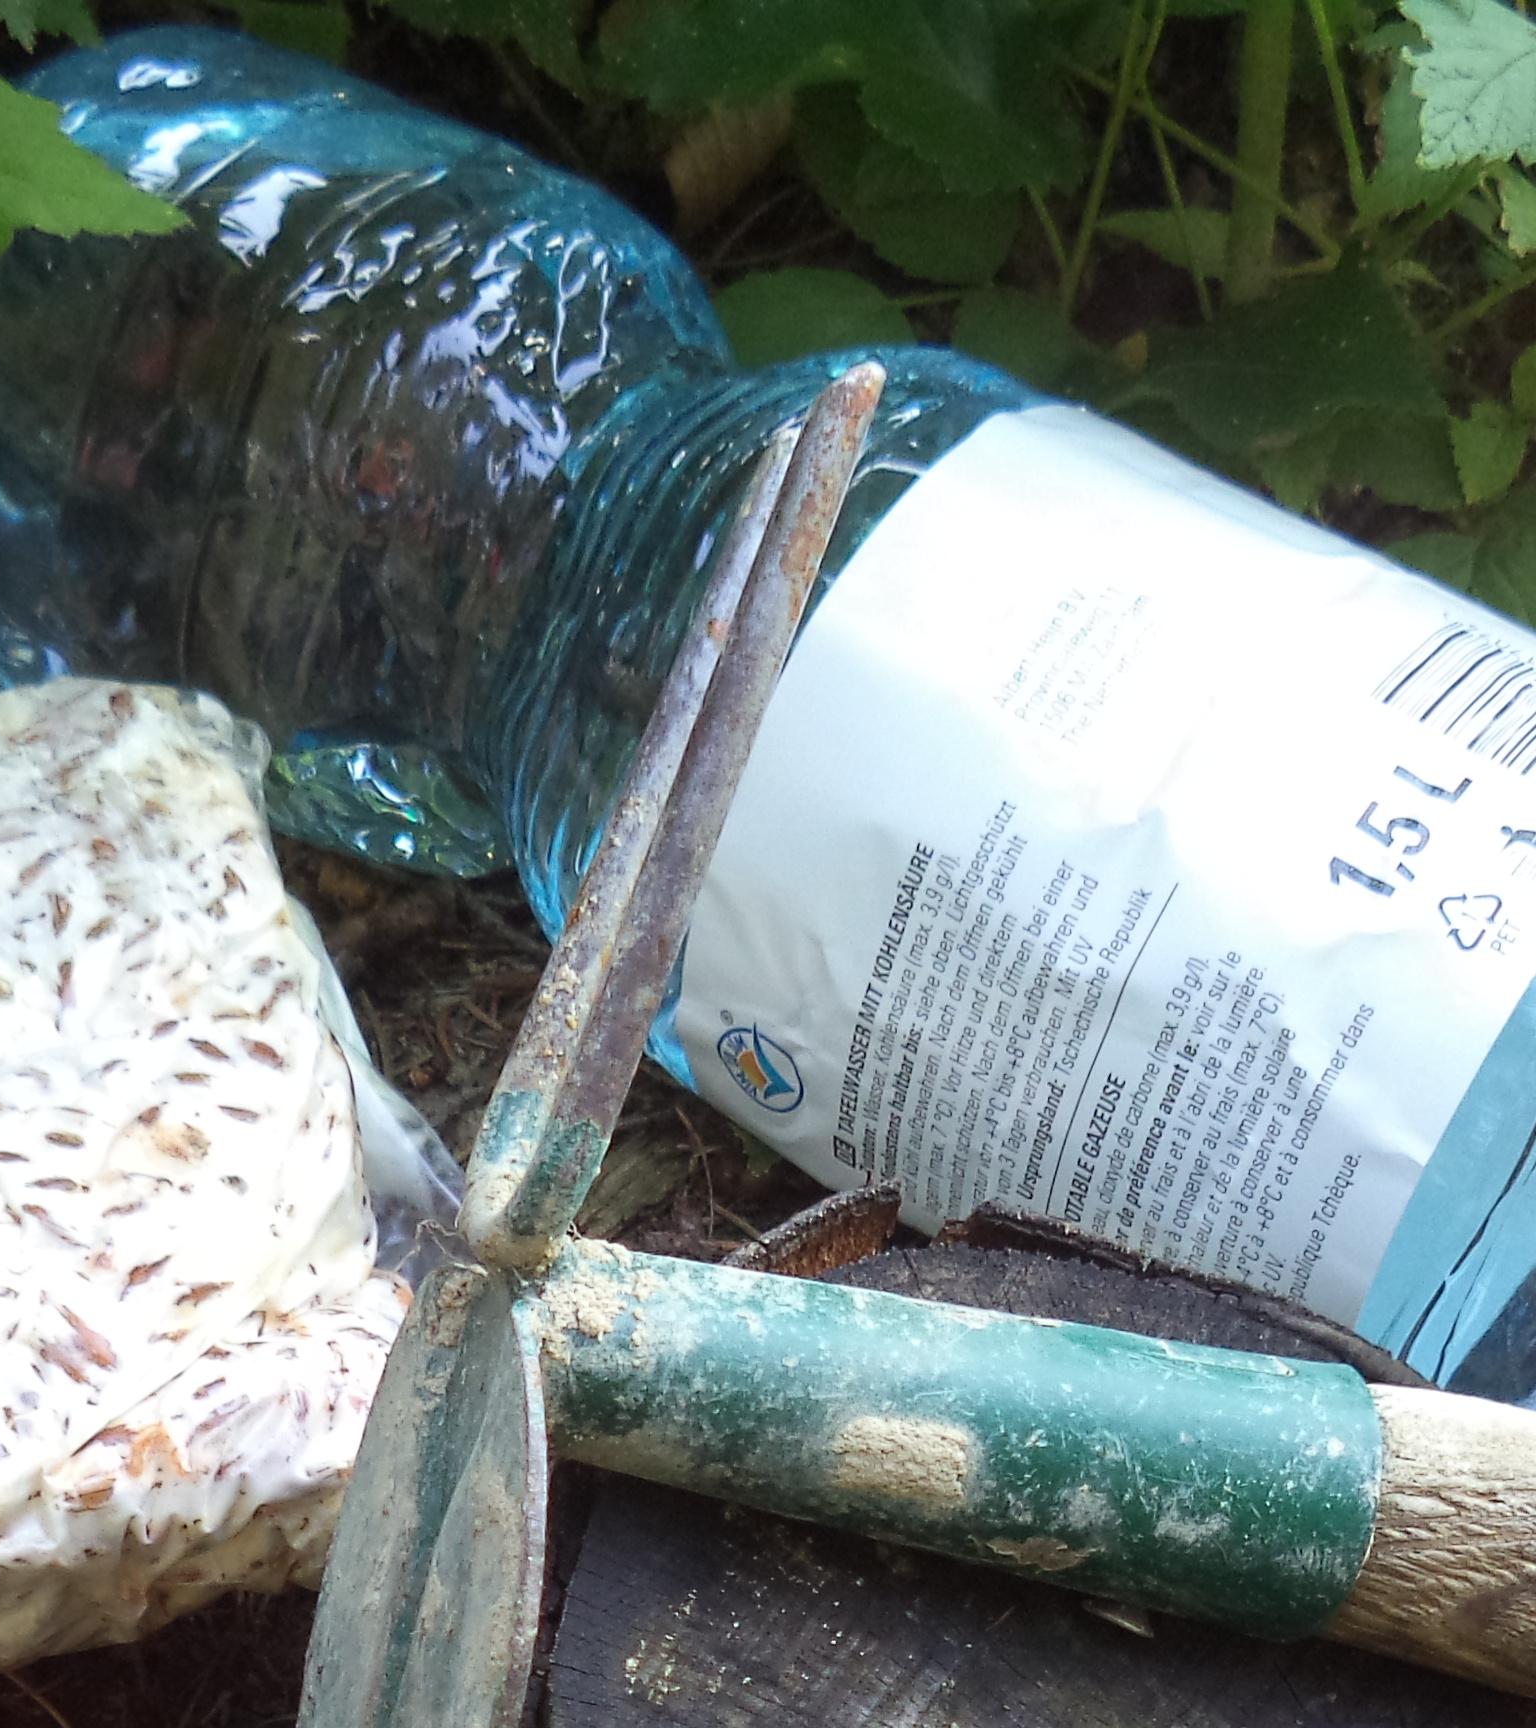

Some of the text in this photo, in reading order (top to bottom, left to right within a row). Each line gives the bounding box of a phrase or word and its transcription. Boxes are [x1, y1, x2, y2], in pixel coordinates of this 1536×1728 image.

[992, 656, 1031, 708] Albert
[1039, 690, 1076, 730] 1506
[1329, 765, 1472, 898] 1,5 L
[936, 854, 960, 890] g/l).
[945, 800, 1017, 923] Lichtgeschützt
[986, 835, 1028, 903] gekühlt
[1043, 859, 1074, 906] einer
[920, 887, 944, 918] 3,9
[1022, 906, 1050, 937] bei
[904, 923, 933, 968] (max.
[931, 930, 957, 973] oben.
[956, 903, 993, 961] Öffnen
[977, 913, 1017, 988] direktem
[1068, 935, 1094, 965] UV
[1489, 919, 1520, 955] PET
[996, 939, 1034, 998] Öffnen
[1218, 951, 1241, 969] le
[838, 1023, 872, 1135] TAFELWASSER
[858, 982, 883, 1024] MIT
[872, 842, 934, 983] KOHLENSÄURE
[916, 975, 940, 1022] siehe
[947, 963, 970, 1002] dem
[992, 1072, 1016, 1098] bis
[1005, 1025, 1032, 1070] +8°C
[1023, 913, 1078, 1026] aufbewahren
[1074, 874, 1099, 911] und
[1054, 967, 1080, 1000] Mit
[1208, 970, 1230, 1001] sur
[1218, 967, 1264, 1034] lumière.
[873, 968, 916, 1066] Kohlensäure
[928, 1004, 957, 1048] Nach
[970, 987, 989, 1024] und
[988, 1000, 1012, 1037] dem
[1191, 1001, 1215, 1035] voir
[1340, 1004, 1374, 1048] dans
[900, 1023, 924, 1055] bis:
[949, 1026, 977, 1067] Hitze
[1016, 888, 1152, 1200] Ursprungsland: Tschechische Republik
[1021, 1006, 1067, 1106] verbrauchen.
[1176, 1039, 1200, 1063] le:
[1209, 1037, 1232, 1054] la
[1261, 1028, 1296, 1085] solaire
[940, 1066, 962, 1093] Vor
[971, 1039, 999, 1083] Nach
[1114, 1126, 1134, 1148] de
[1125, 1062, 1160, 1126] carbone
[1148, 1021, 1179, 1063] (max.
[1165, 987, 1191, 1017] 3,9
[1200, 1056, 1222, 1079] de
[1226, 1041, 1261, 1086] (max.
[862, 1069, 889, 1122] Wasser,
[888, 1054, 914, 1112] haltbar
[907, 1054, 941, 1150] aufbewahren.
[1159, 1063, 1189, 1115] avant
[1291, 1049, 1349, 1150] consommer
[955, 1088, 984, 1155] schützen.
[1208, 1086, 1239, 1125] frais
[1227, 1087, 1270, 1151] lumière
[931, 1124, 947, 1138] 7
[1001, 1109, 1028, 1154] Tagen
[1064, 1072, 1126, 1223] OTABLE GAZEUSE
[1169, 1140, 1187, 1160] et
[1172, 1127, 1192, 1141] à
[1203, 1126, 1221, 1150] au
[1230, 1200, 1249, 1214] à
[1240, 1116, 1283, 1199] conserver
[1273, 1102, 1292, 1116] à
[1284, 1066, 1307, 1100] une
[998, 1153, 1016, 1168] 3
[1126, 1117, 1167, 1209] préférence
[1151, 1161, 1178, 1198] frais
[1219, 1152, 1240, 1170] la
[1275, 1166, 1293, 1186] et
[1279, 1152, 1299, 1165] à
[997, 1168, 1013, 1195] von
[1173, 1150, 1211, 1229] conserver
[1211, 1171, 1231, 1194] de
[1311, 1154, 1362, 1226] Tchèque.
[1116, 1207, 1135, 1228] de
[1148, 1199, 1165, 1222] au
[1207, 1194, 1223, 1215] et
[1256, 1184, 1283, 1231] +8°C
[1163, 1230, 1182, 1243] à
[1246, 1234, 1265, 1248] à
[1261, 1252, 1286, 1282] UV.
